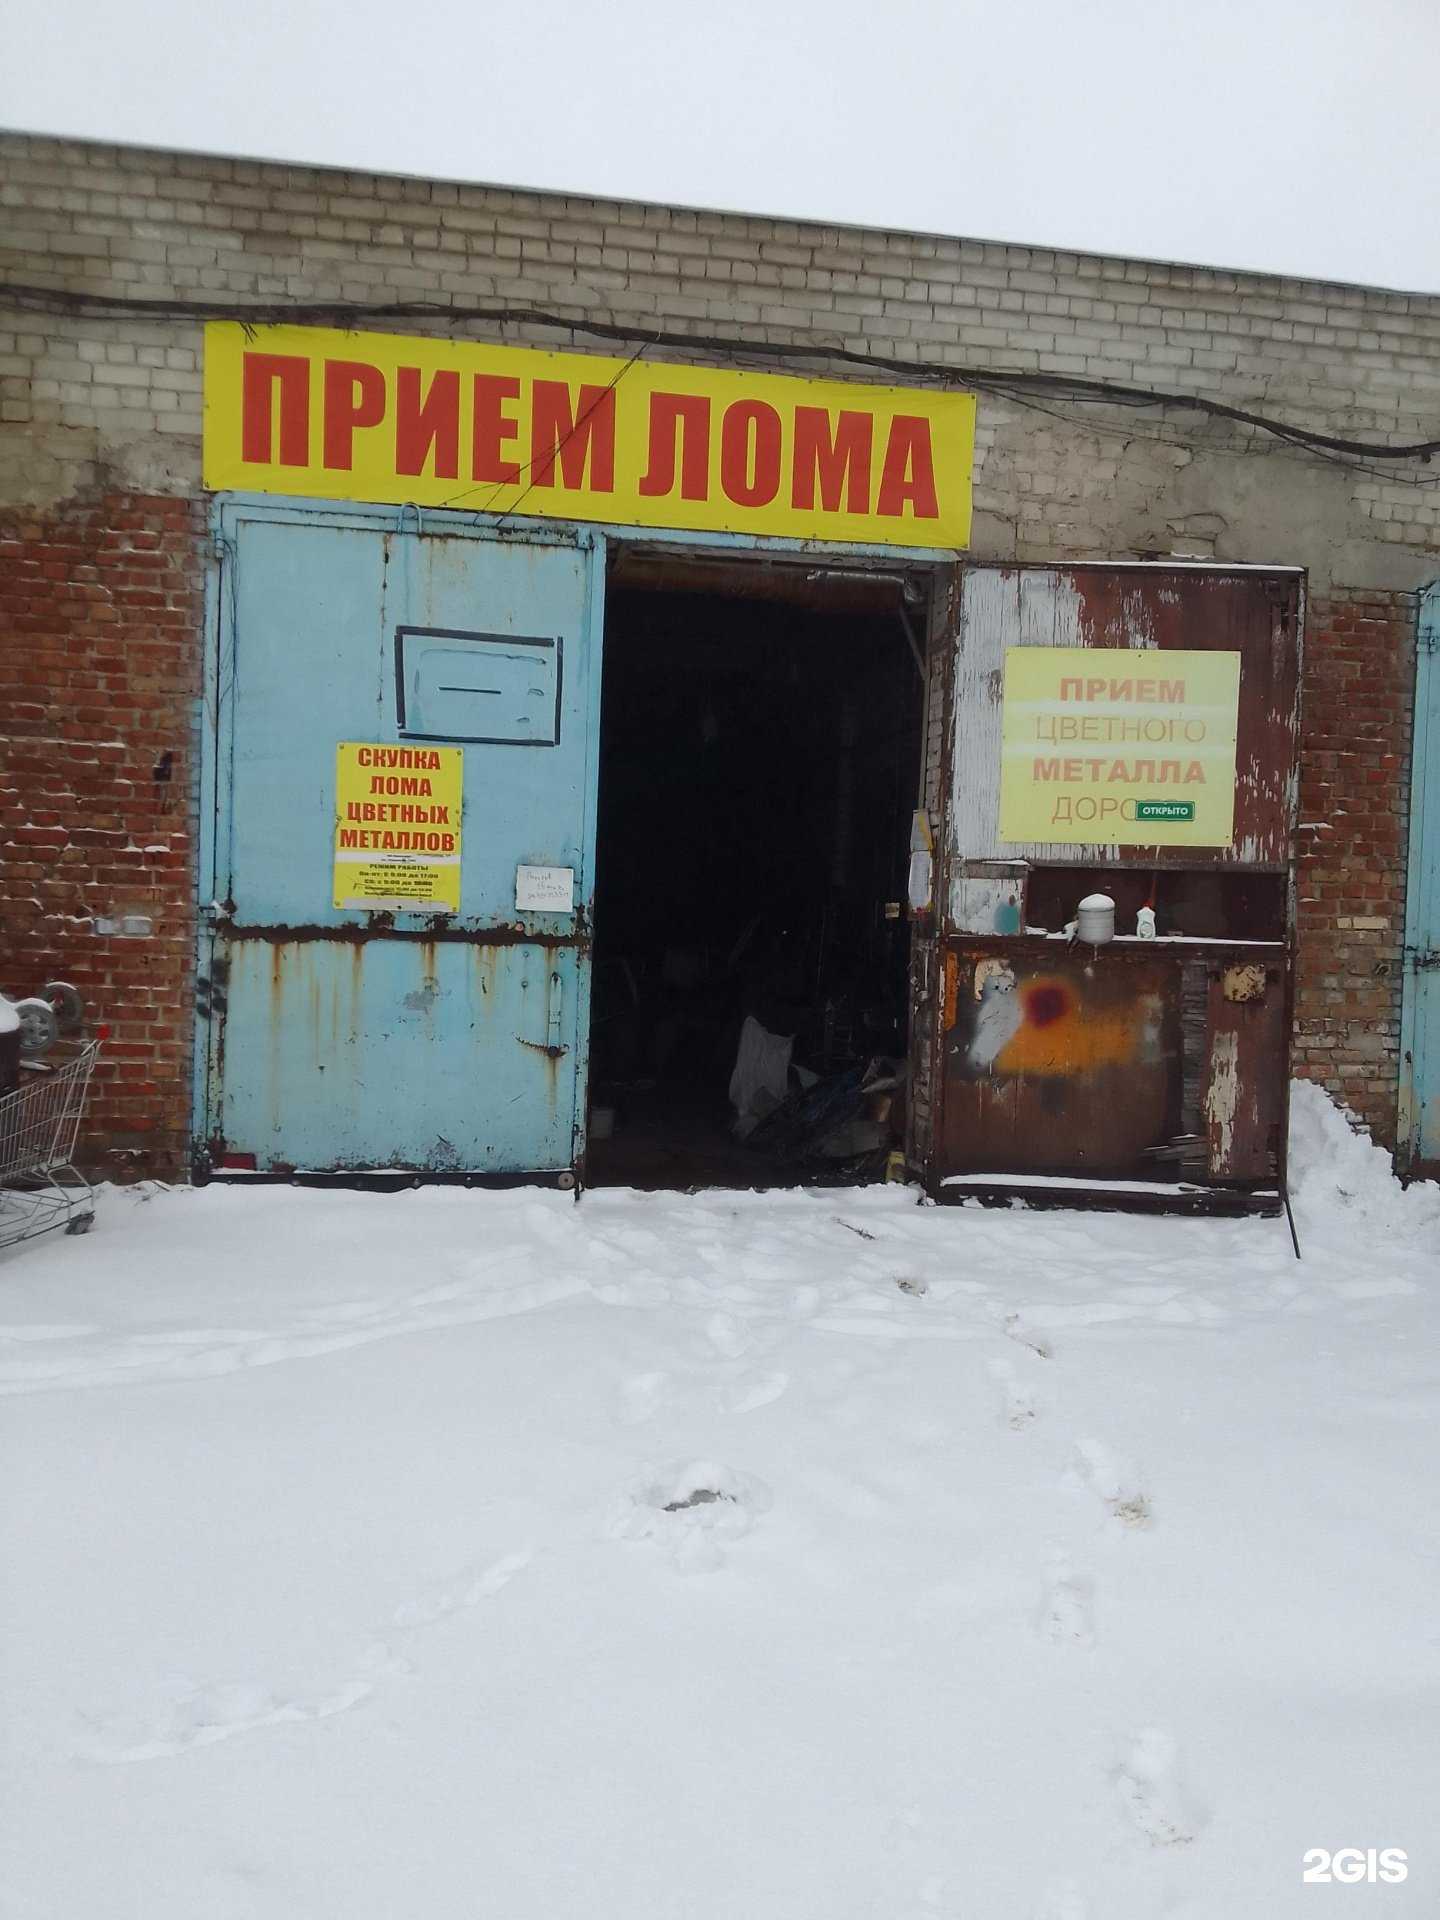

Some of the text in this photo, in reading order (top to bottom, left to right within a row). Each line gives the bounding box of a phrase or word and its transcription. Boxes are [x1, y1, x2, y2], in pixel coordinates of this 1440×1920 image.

[242, 351, 940, 520] ПРИЕМ ЛОМА
[1060, 677, 1186, 704] ПРИЕМ
[1036, 715, 1207, 746] ЦВЕТНОГО
[358, 747, 441, 770] СКУПКА
[1033, 757, 1207, 785] МЕТАЛЛА
[369, 775, 432, 797] ЛОМА
[347, 802, 449, 824] ЦВЕТНЫХ
[1052, 796, 1180, 825] ДОРО
[1142, 806, 1189, 816] ОТКРЫТО
[339, 829, 455, 852] МЕТАЛЛОВ
